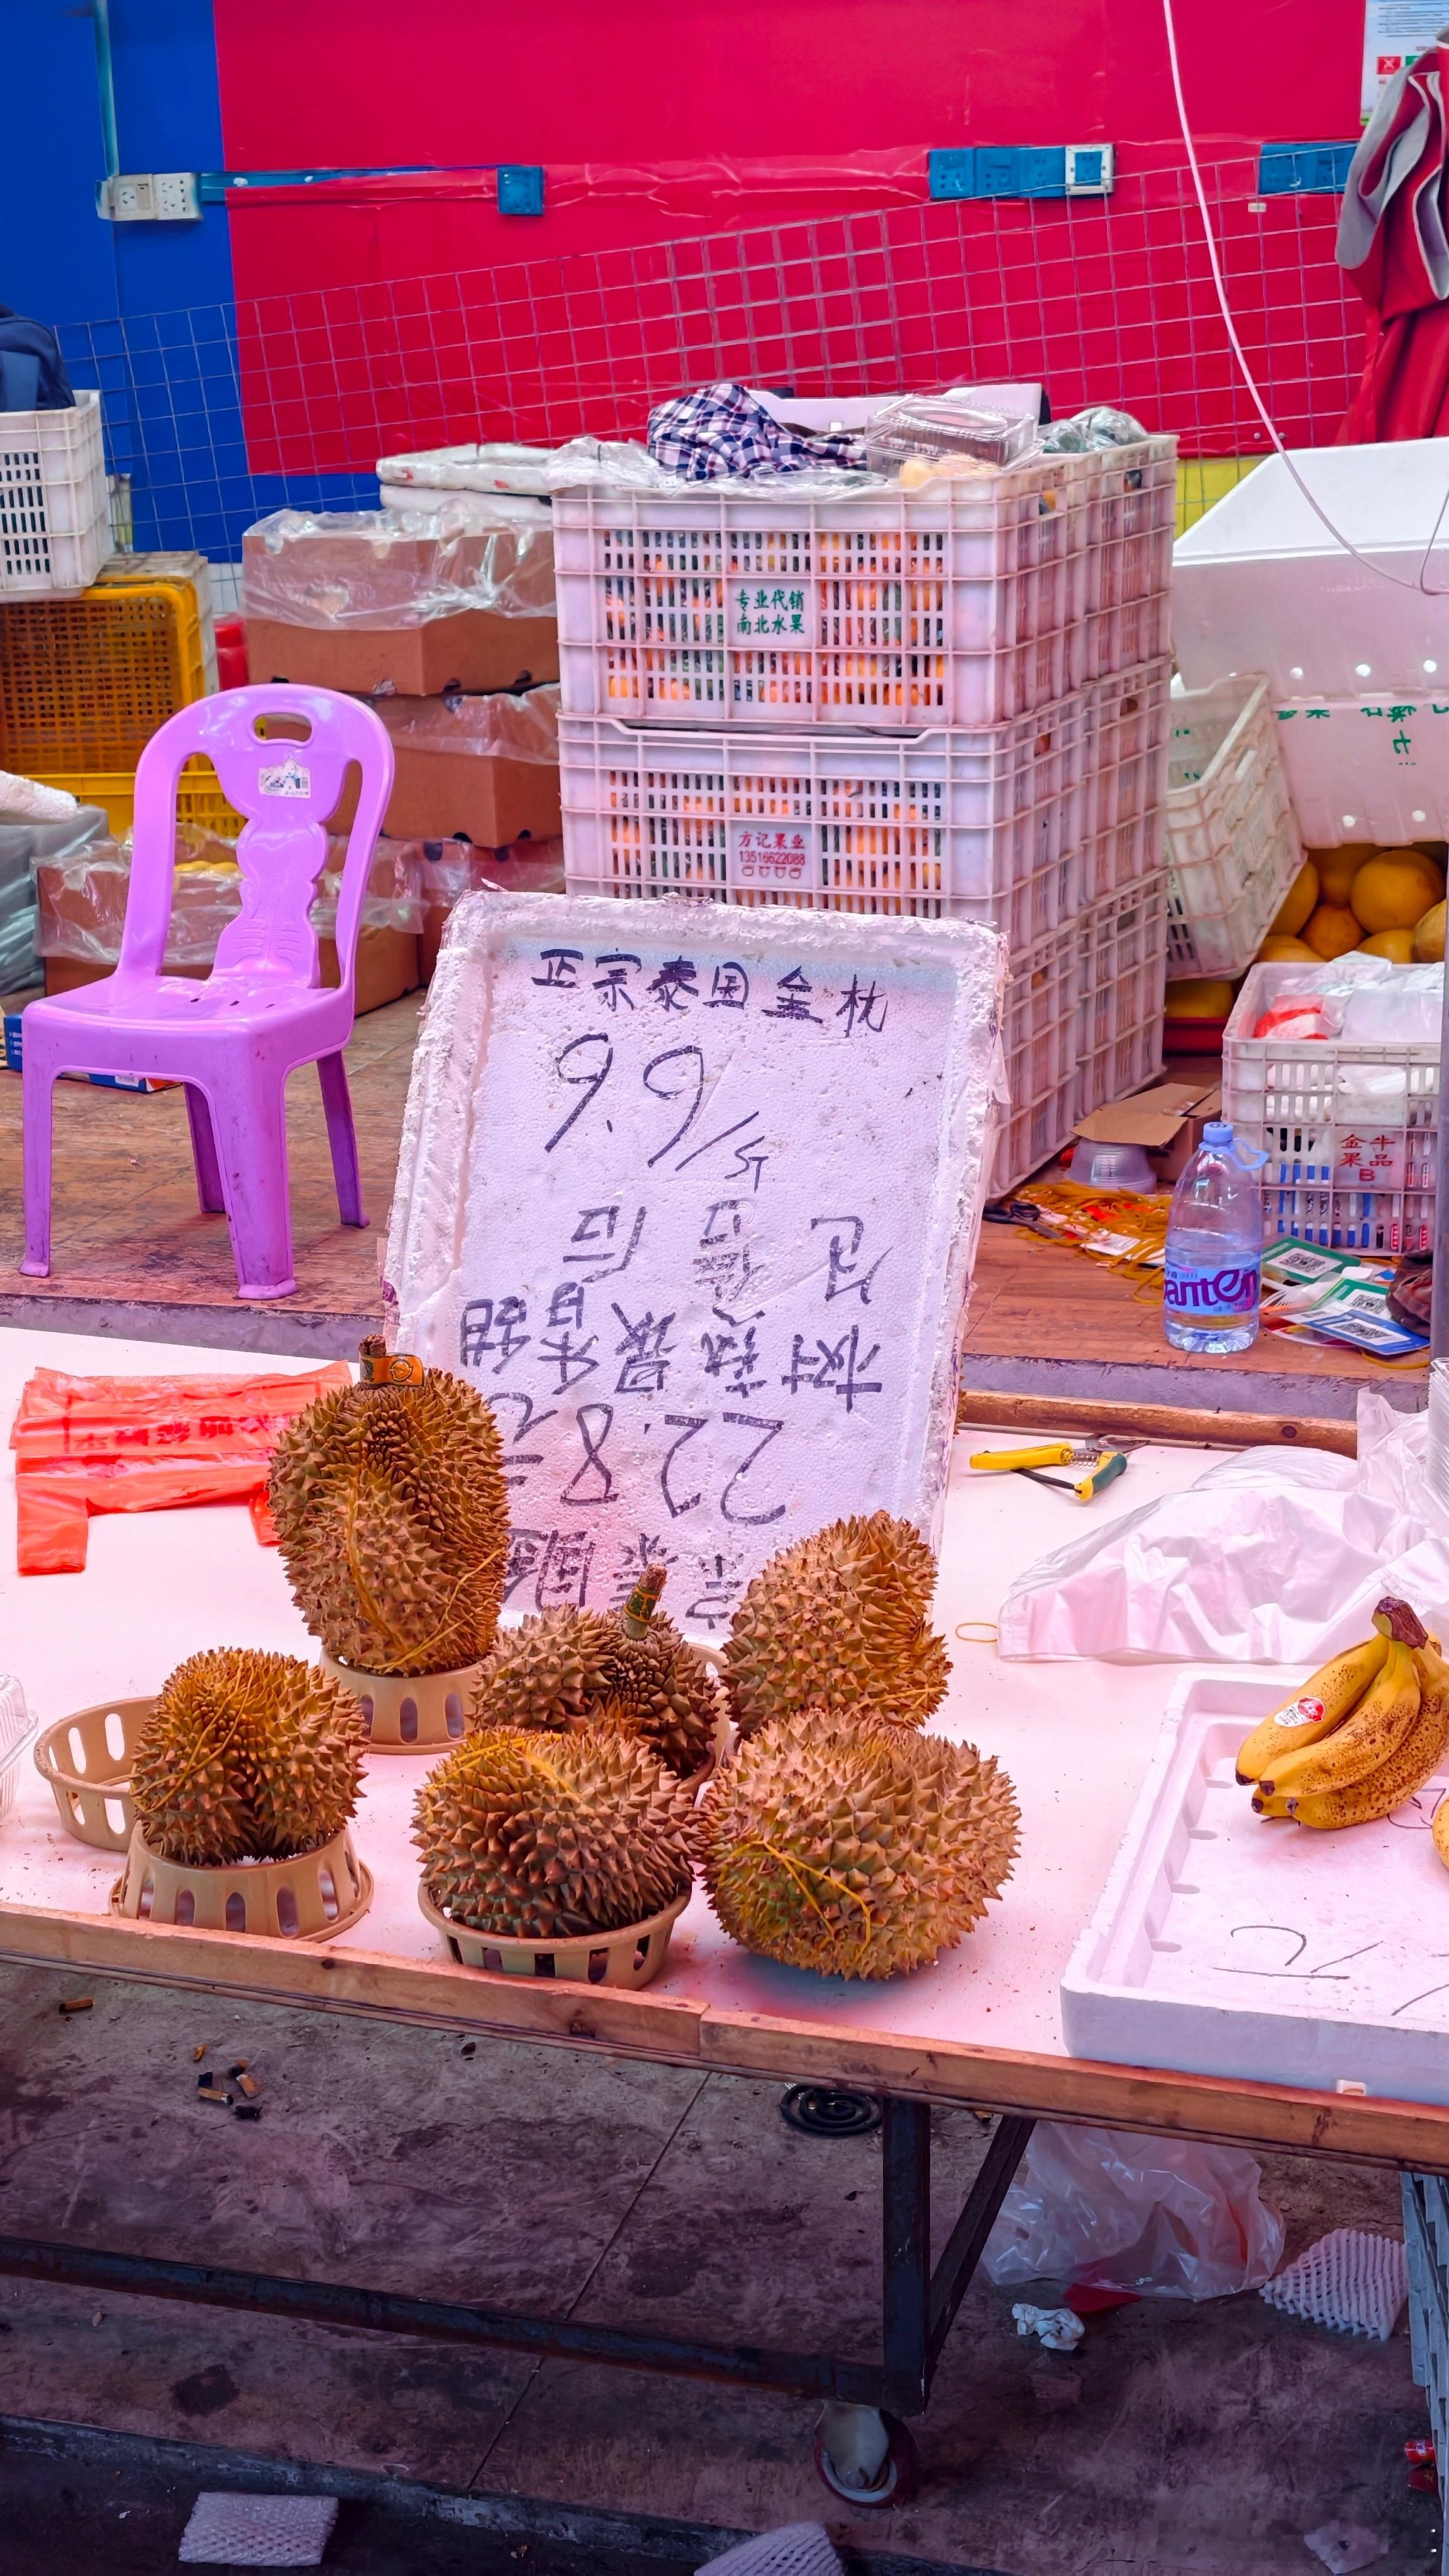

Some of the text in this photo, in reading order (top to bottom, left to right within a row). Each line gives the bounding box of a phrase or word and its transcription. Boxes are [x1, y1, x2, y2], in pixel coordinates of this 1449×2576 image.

[735, 589, 804, 611] 专业代销
[736, 614, 805, 635] 南北水果
[738, 831, 805, 849] 方记果业
[531, 948, 887, 1038] 正宗泰国金枕
[1340, 1133, 1396, 1152] 金牛
[1339, 1152, 1393, 1167] 果品
[1359, 1168, 1375, 1182] B
